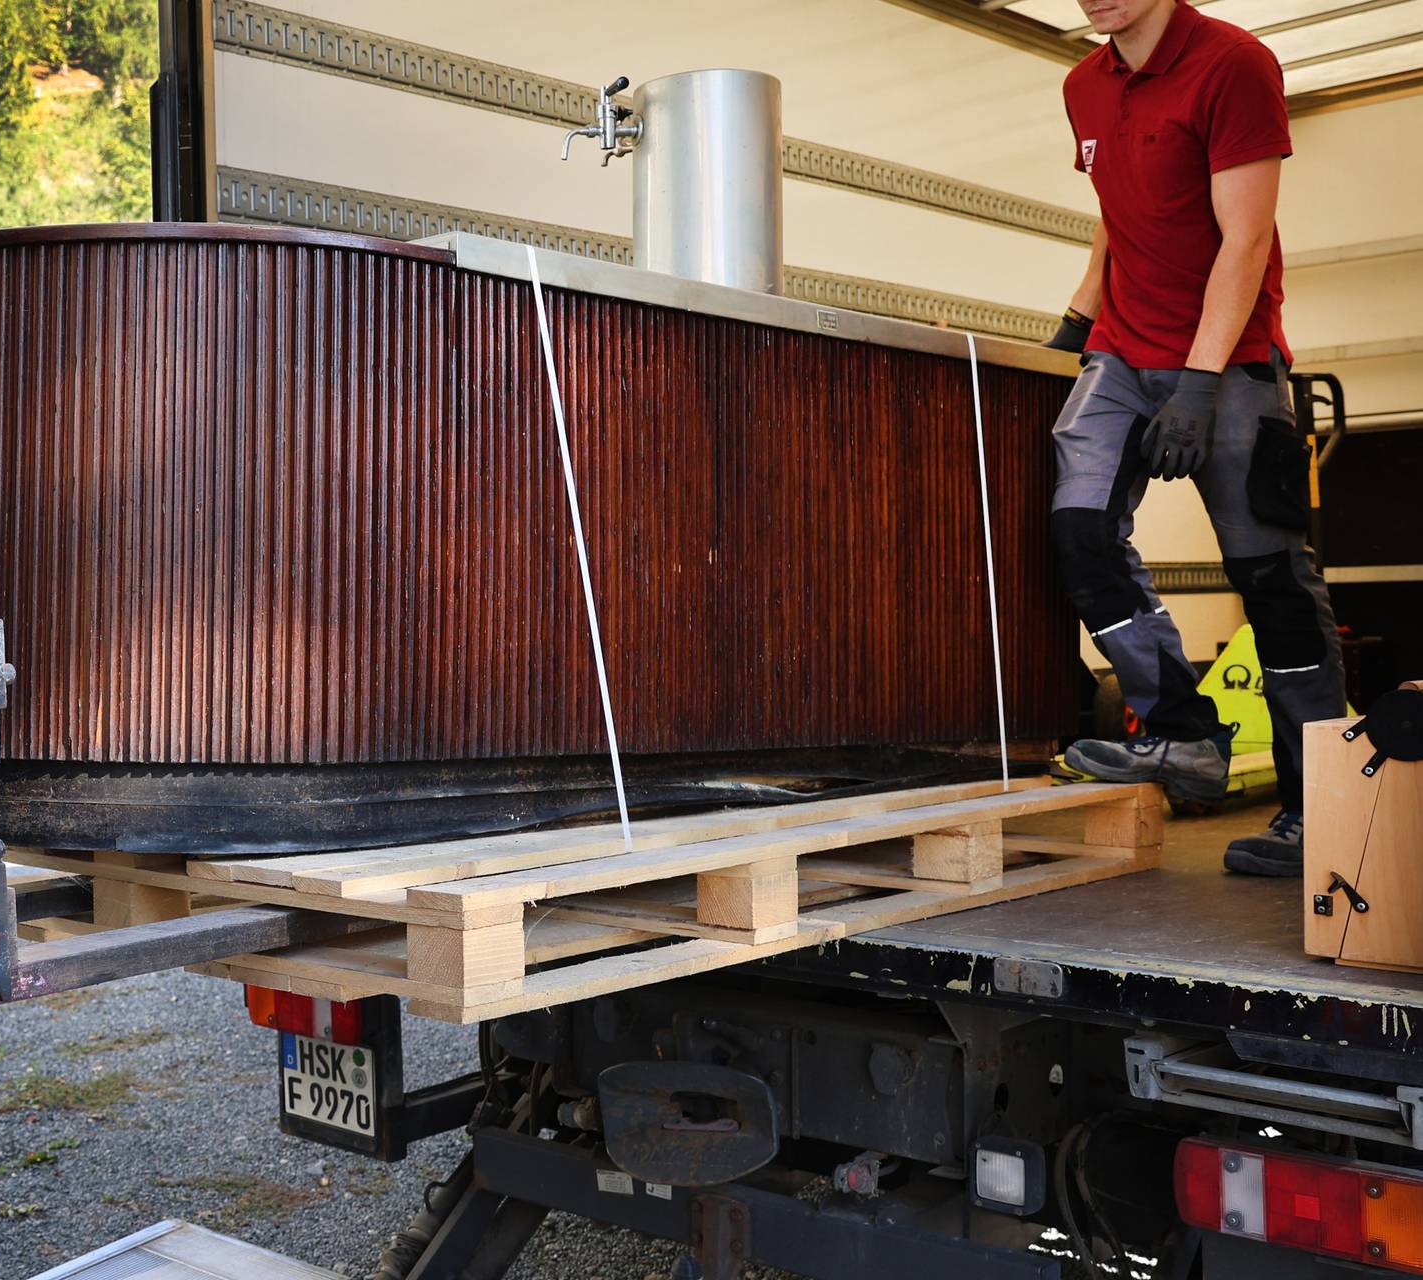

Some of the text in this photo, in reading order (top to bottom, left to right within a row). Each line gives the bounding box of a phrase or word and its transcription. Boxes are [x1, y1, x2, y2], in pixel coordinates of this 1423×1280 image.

[287, 1054, 294, 1065] D
[299, 1039, 347, 1085] HSK
[288, 1076, 371, 1130] F 9970
